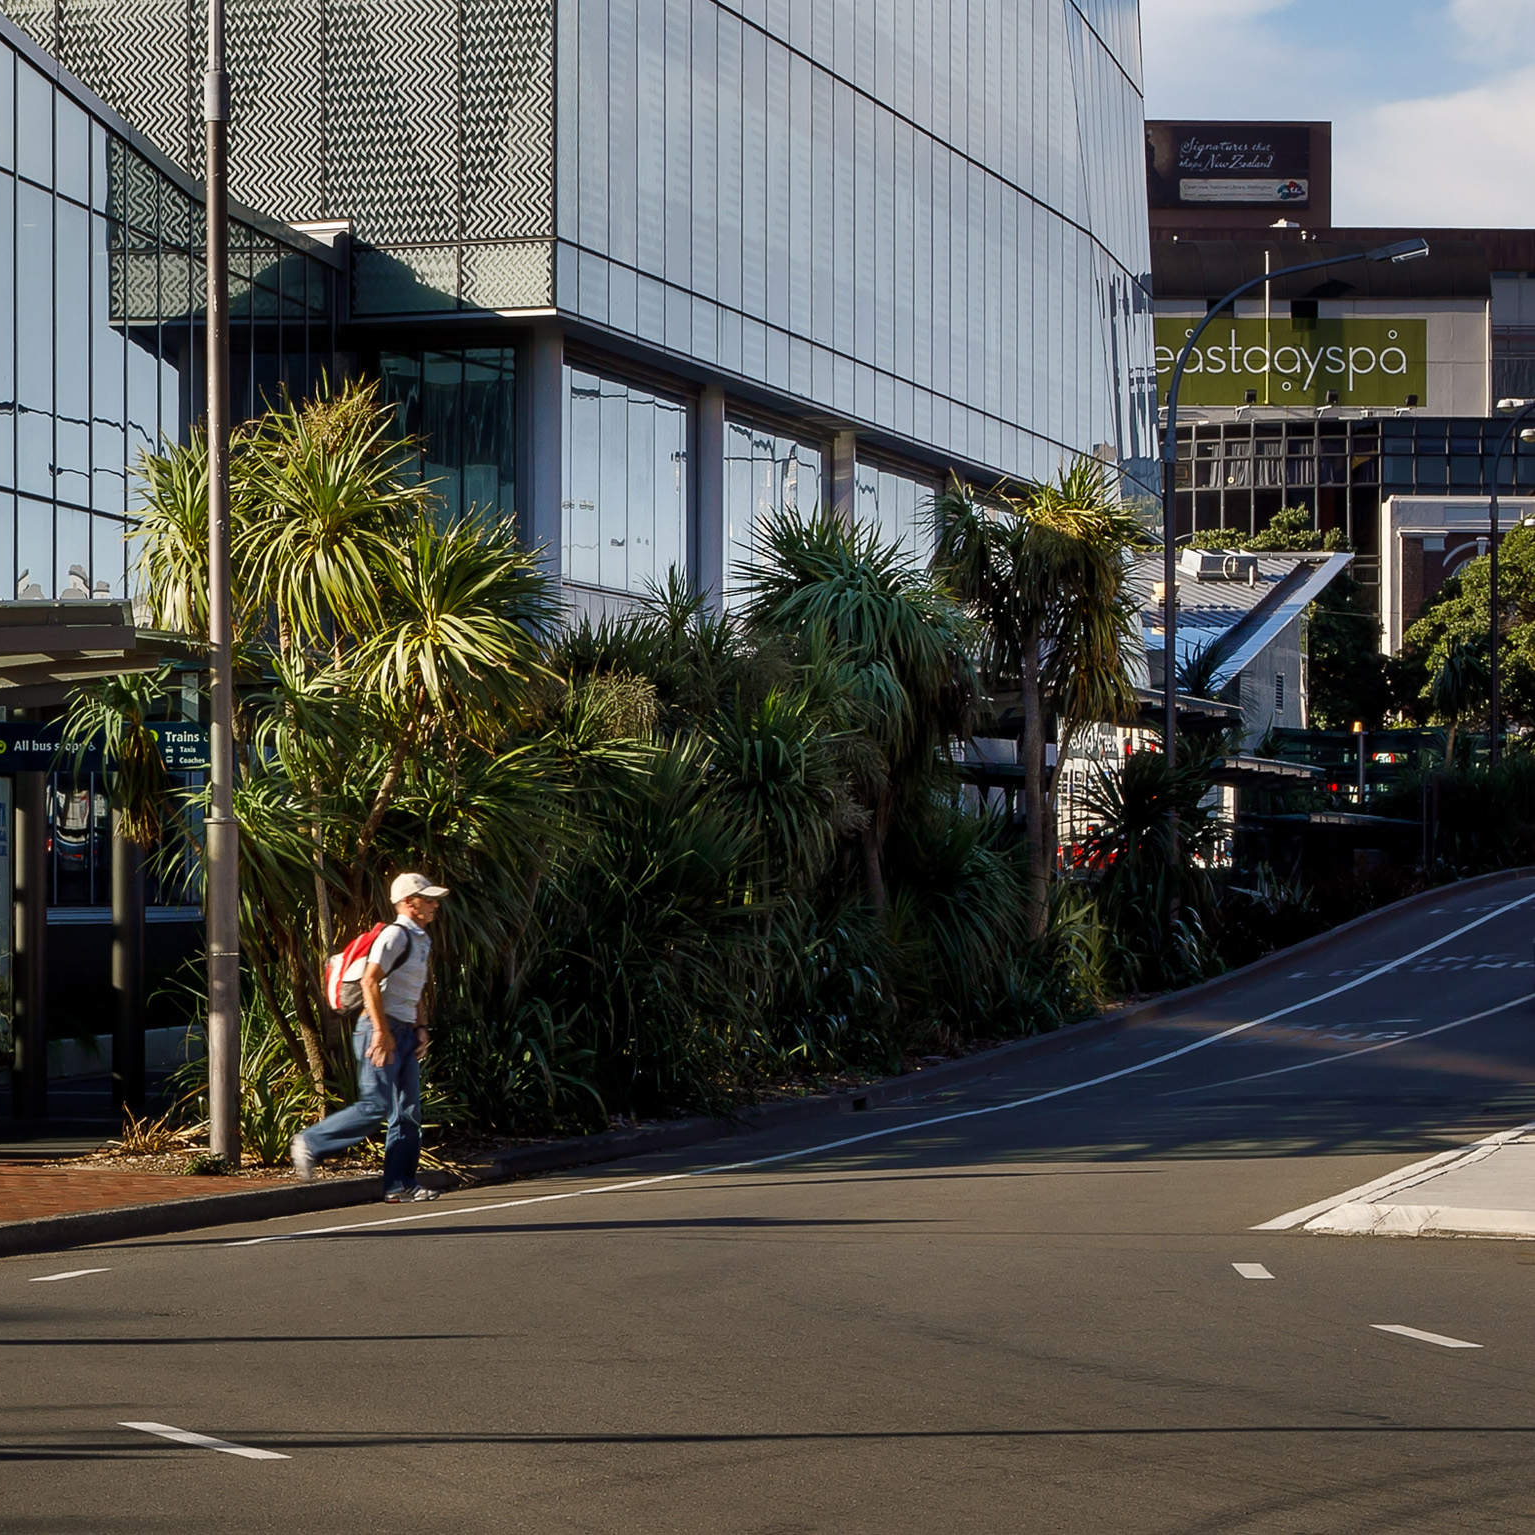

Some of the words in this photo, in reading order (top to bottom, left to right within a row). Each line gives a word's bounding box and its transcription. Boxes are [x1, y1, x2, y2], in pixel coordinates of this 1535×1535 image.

[164, 730, 200, 743] Trains
[13, 740, 29, 752] All
[32, 740, 52, 752] bus
[54, 742, 84, 754] sop
[179, 745, 197, 753] Taxis
[179, 756, 206, 764] Coaches
